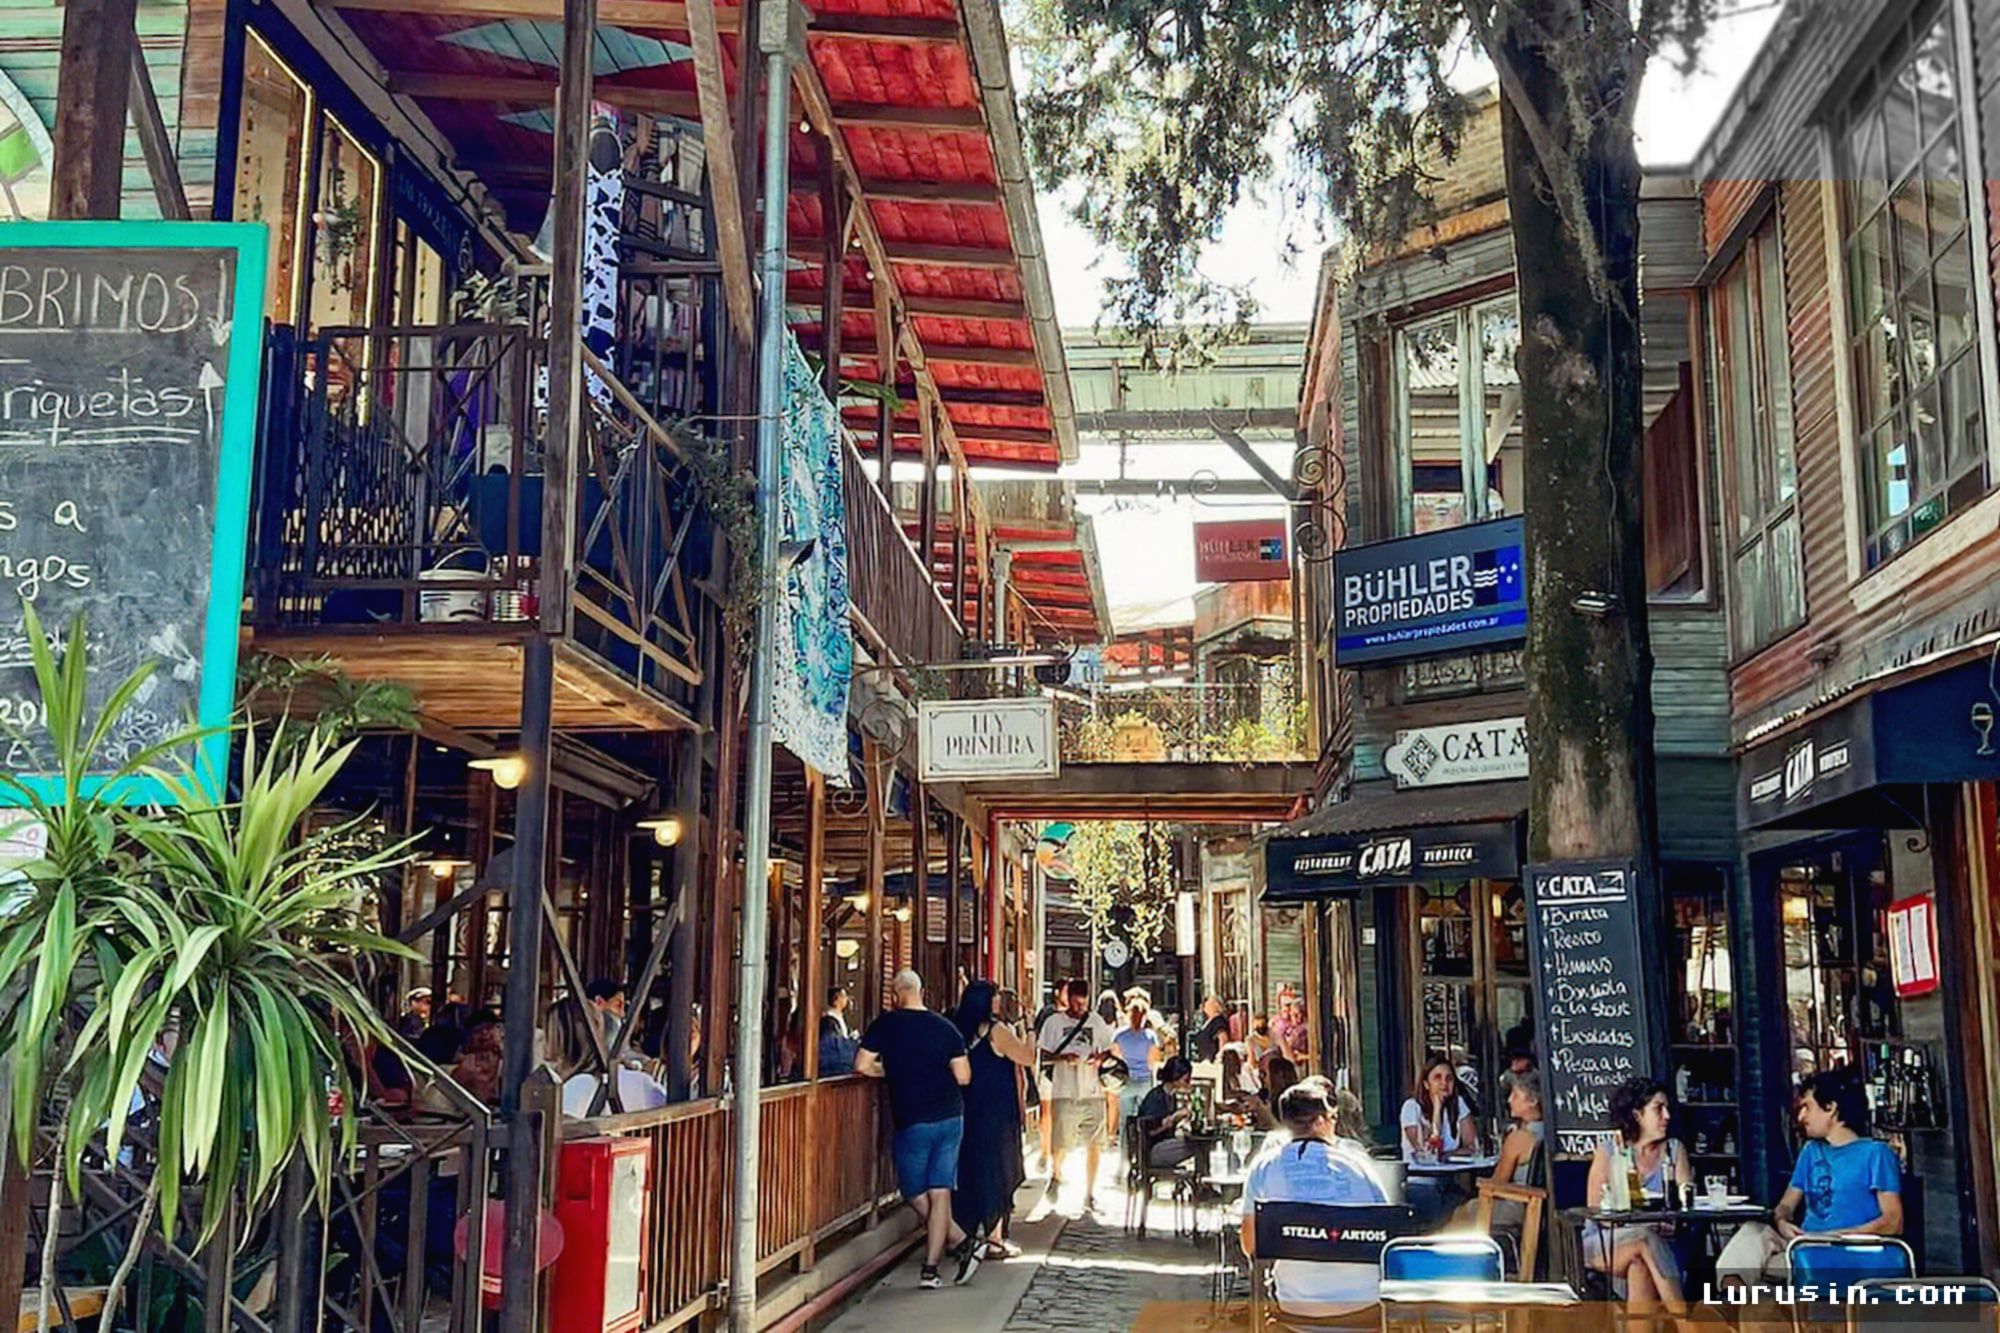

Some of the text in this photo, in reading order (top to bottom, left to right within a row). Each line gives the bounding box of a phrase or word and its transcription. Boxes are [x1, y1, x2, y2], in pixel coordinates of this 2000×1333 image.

[54, 500, 88, 532] a
[1344, 588, 1475, 628] PROPIEDADES
[1442, 727, 1529, 762] CATA
[1358, 838, 1412, 877] CATA
[1548, 876, 1597, 897] CATA
[1551, 1003, 1566, 1016] a
[1281, 1225, 1388, 1242] STELLA ARTOIS
